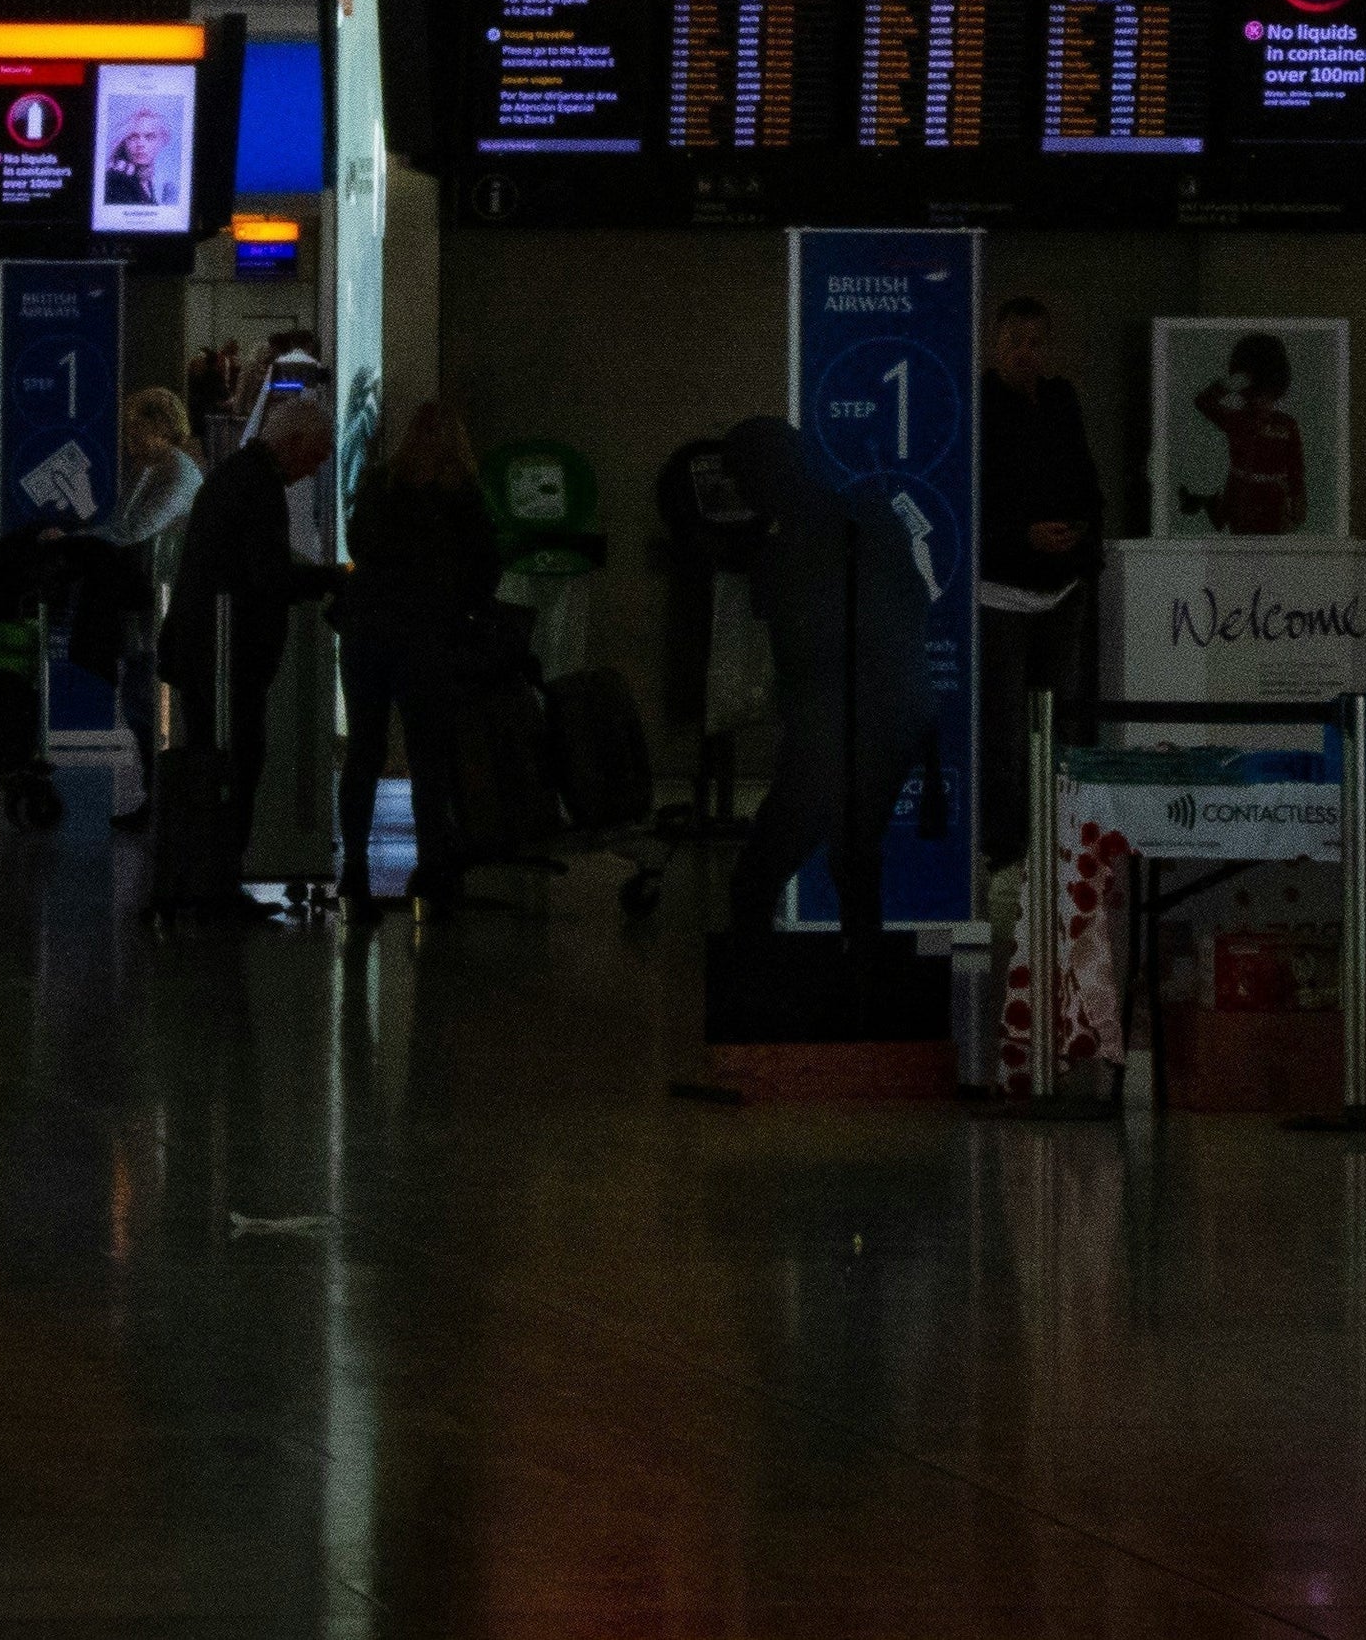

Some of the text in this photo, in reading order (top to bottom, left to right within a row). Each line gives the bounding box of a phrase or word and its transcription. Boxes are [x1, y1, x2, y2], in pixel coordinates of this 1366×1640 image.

[1267, 24, 1358, 44] No liquids
[1266, 45, 1283, 61] in
[1265, 66, 1365, 84] over 100ml
[827, 275, 909, 294] BRITISH
[823, 295, 913, 313] AIRWAYS
[59, 349, 76, 419] 1
[829, 359, 909, 460] STEP 1
[1201, 804, 1338, 827] CONTACTLESS
